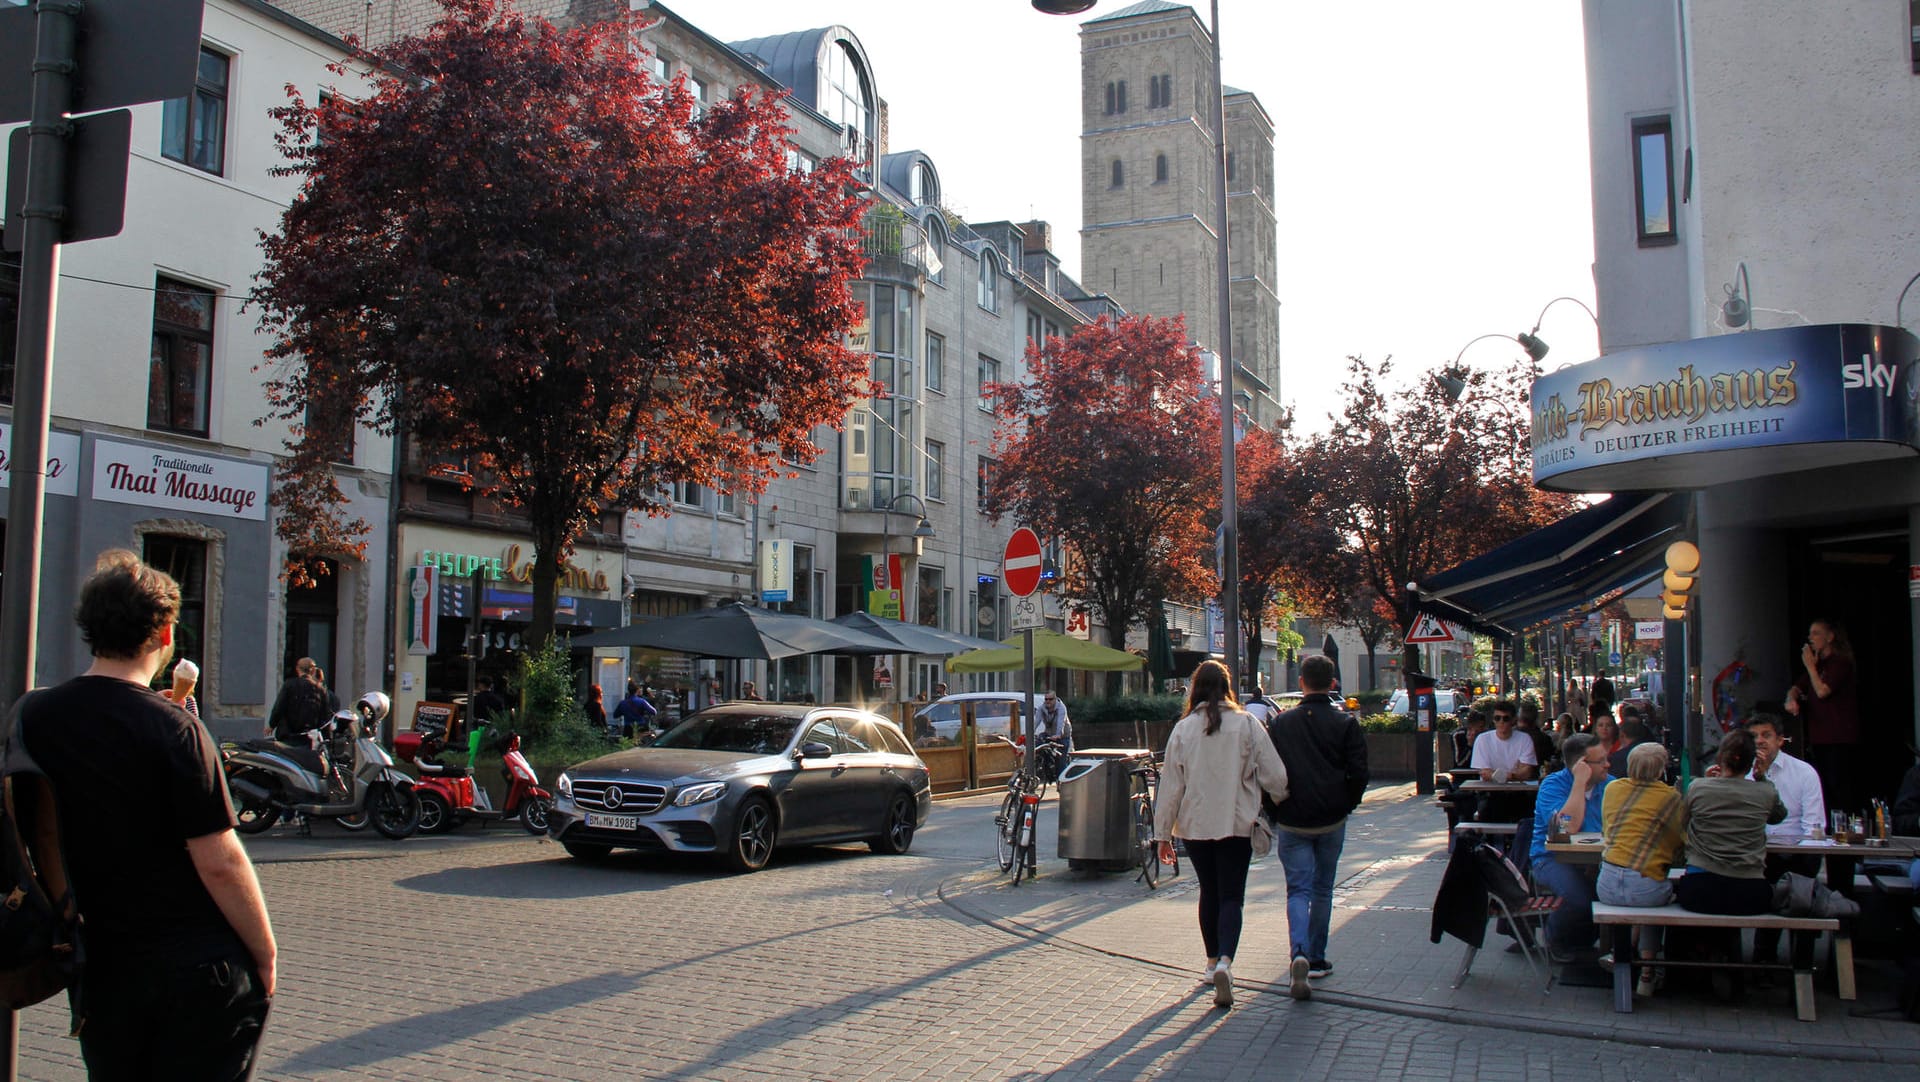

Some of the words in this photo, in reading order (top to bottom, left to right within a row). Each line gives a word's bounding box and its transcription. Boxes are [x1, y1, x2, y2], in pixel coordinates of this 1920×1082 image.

[1842, 353, 1897, 397] sky
[1594, 429, 1676, 454] DEUTZER
[1683, 418, 1785, 443] FREIHEIT
[152, 454, 214, 475] Traditionelle
[106, 462, 157, 494] Thai
[164, 471, 256, 513] Massage
